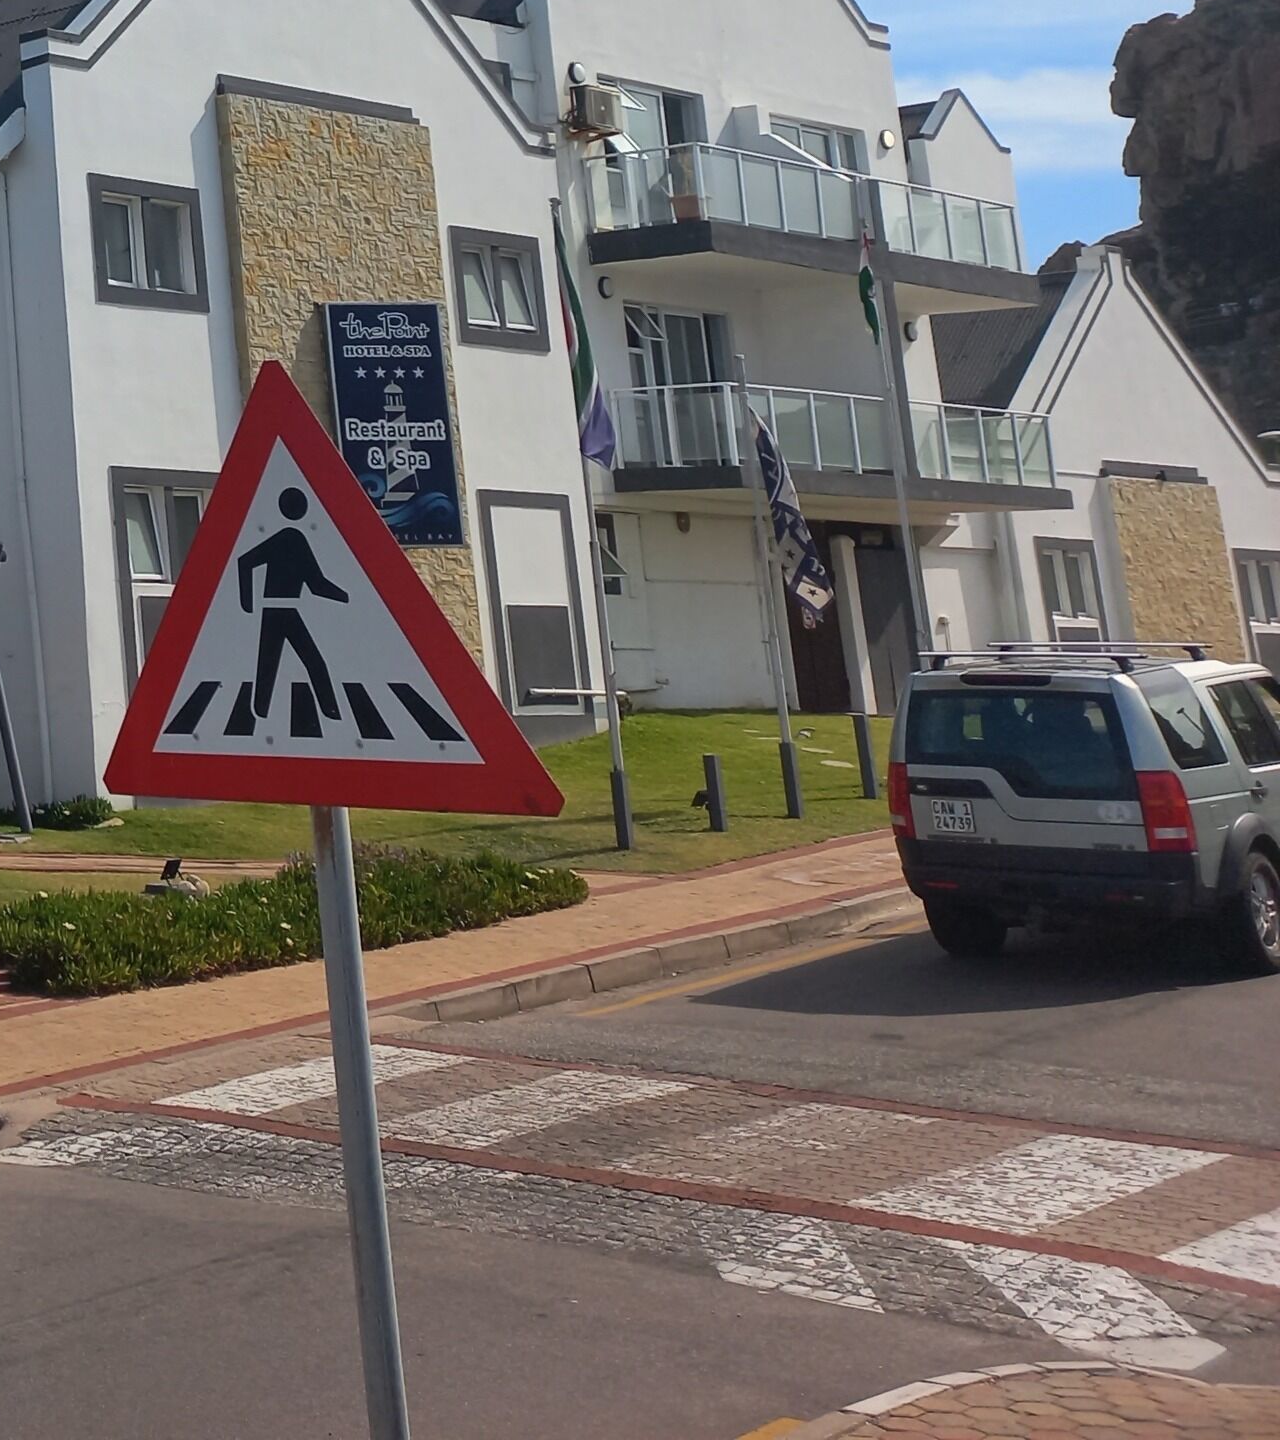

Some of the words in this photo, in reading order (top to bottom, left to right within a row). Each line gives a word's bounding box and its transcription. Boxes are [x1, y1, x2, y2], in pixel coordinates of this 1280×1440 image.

[338, 312, 384, 339] the
[378, 311, 431, 339] Point
[343, 345, 390, 357] HOTEL
[391, 345, 401, 357] &
[404, 345, 431, 357] SPA
[345, 418, 446, 441] Restaurant
[368, 446, 385, 469] &
[393, 448, 431, 472] Spa
[932, 800, 955, 815] CAW
[963, 803, 970, 816] 1
[935, 815, 972, 830] 24739
